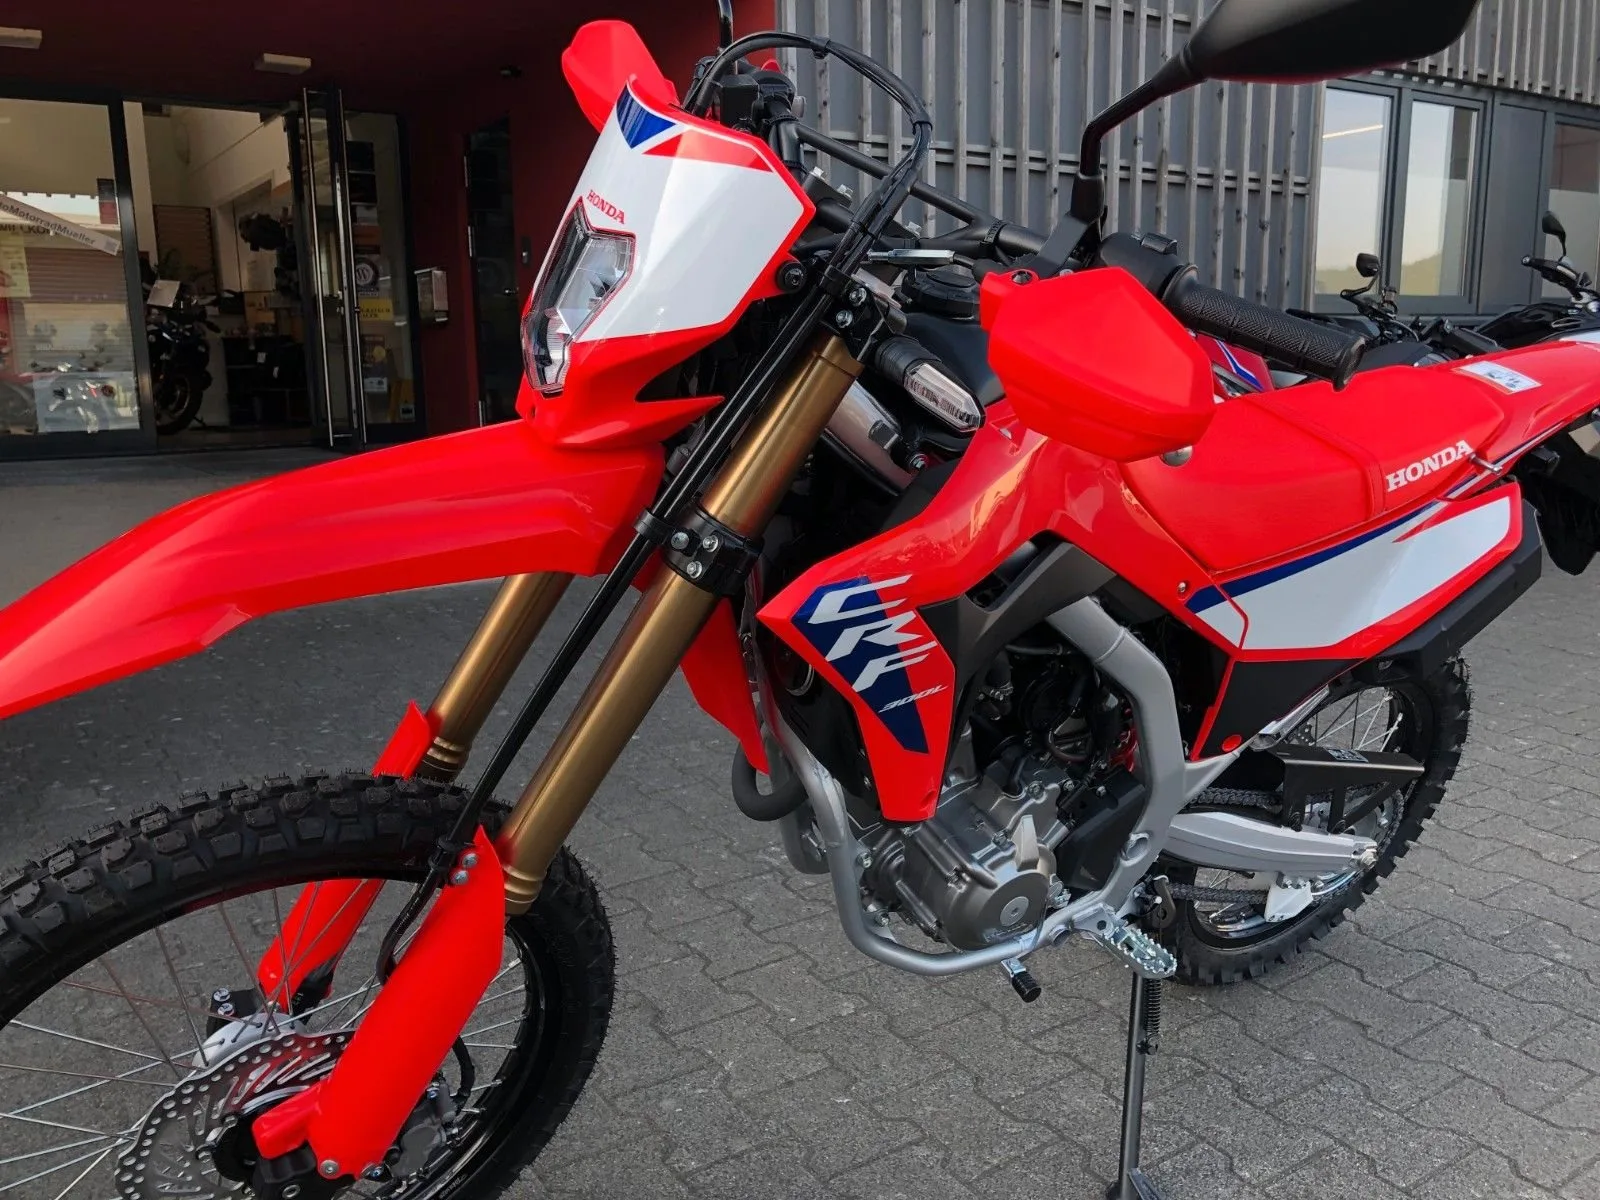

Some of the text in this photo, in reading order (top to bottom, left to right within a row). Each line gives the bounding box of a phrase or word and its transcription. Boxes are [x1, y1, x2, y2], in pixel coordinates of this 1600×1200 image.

[586, 189, 625, 225] HONDA
[1384, 439, 1475, 493] HONDA
[807, 574, 938, 693] CRF
